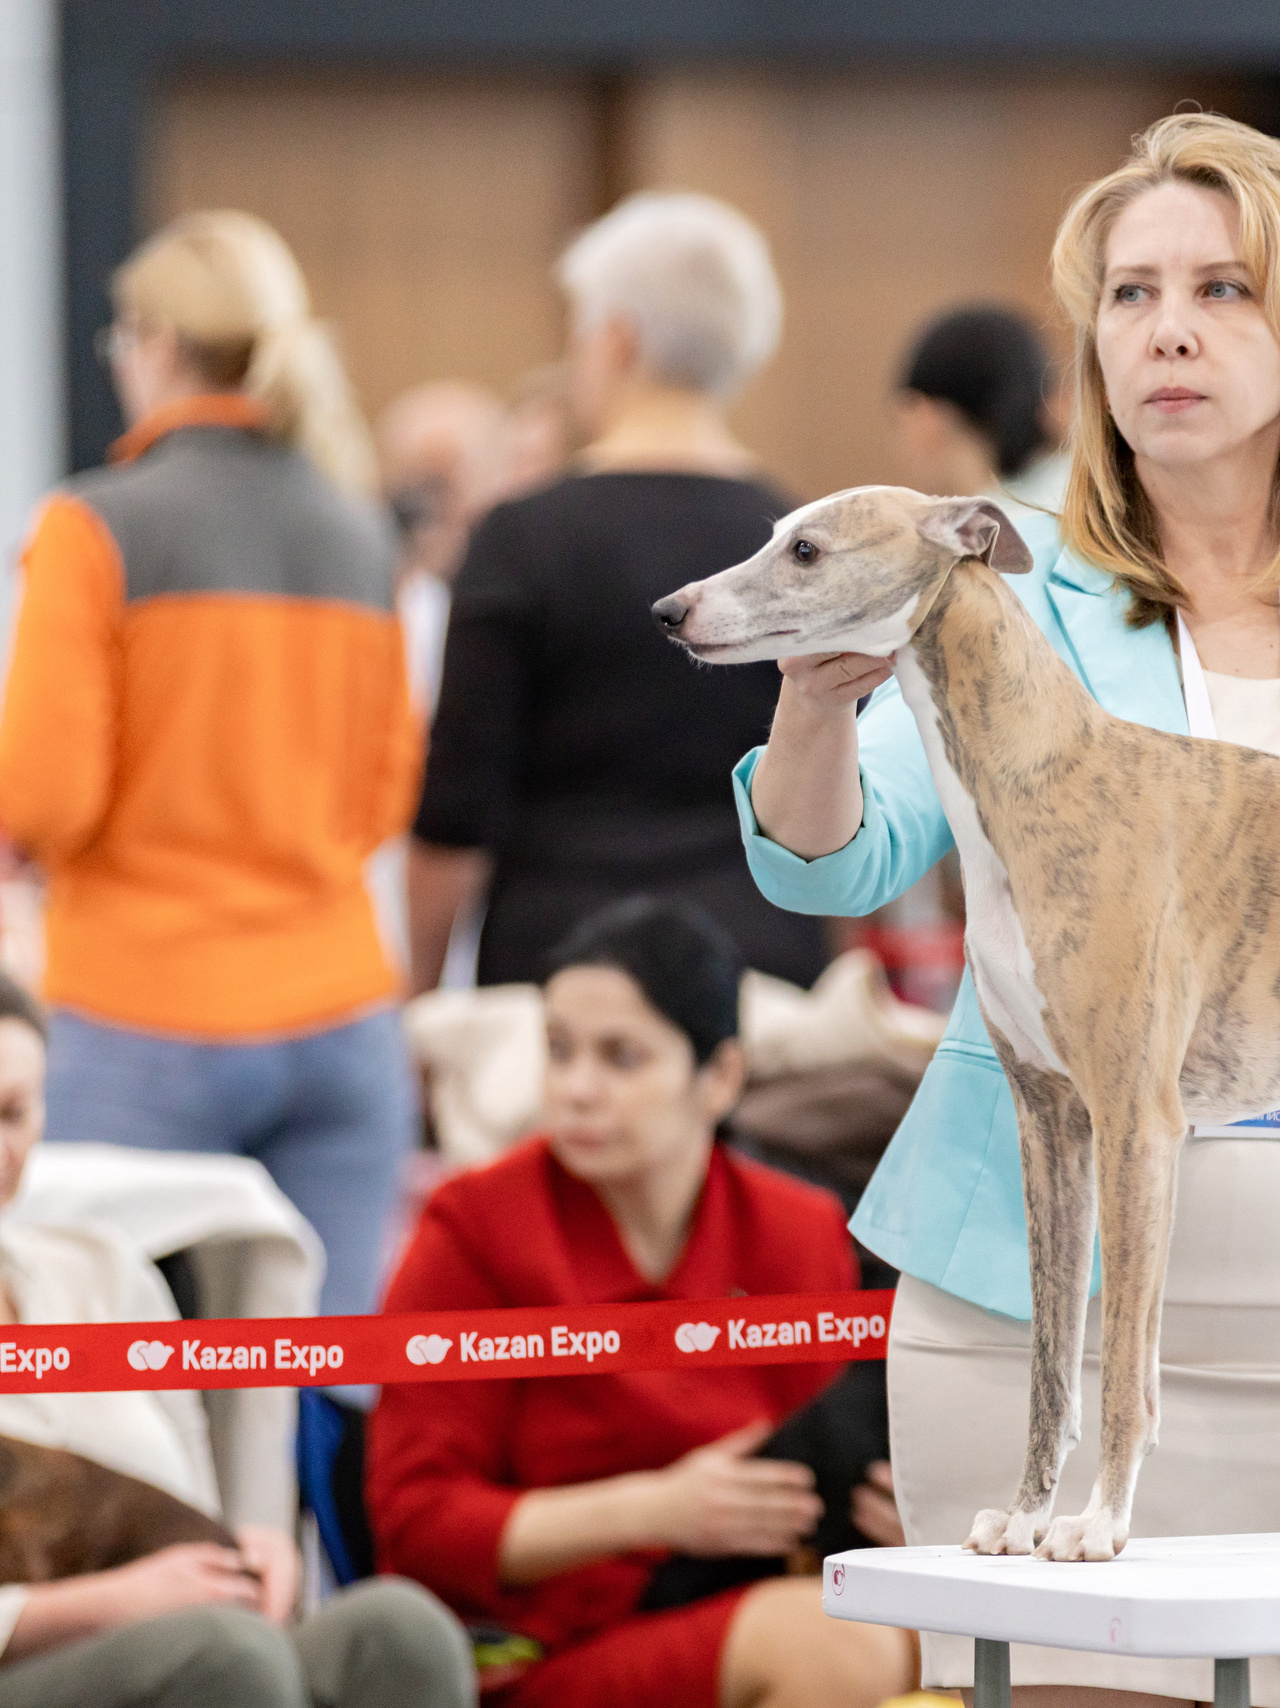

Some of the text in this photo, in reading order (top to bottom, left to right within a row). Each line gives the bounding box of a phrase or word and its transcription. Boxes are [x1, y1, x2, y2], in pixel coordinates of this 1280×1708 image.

[460, 1326, 620, 1362] Kazan Expo
[728, 1312, 886, 1349] Kazan Expo
[0, 1342, 70, 1380] Expo
[182, 1339, 344, 1377] Kazan Expo
